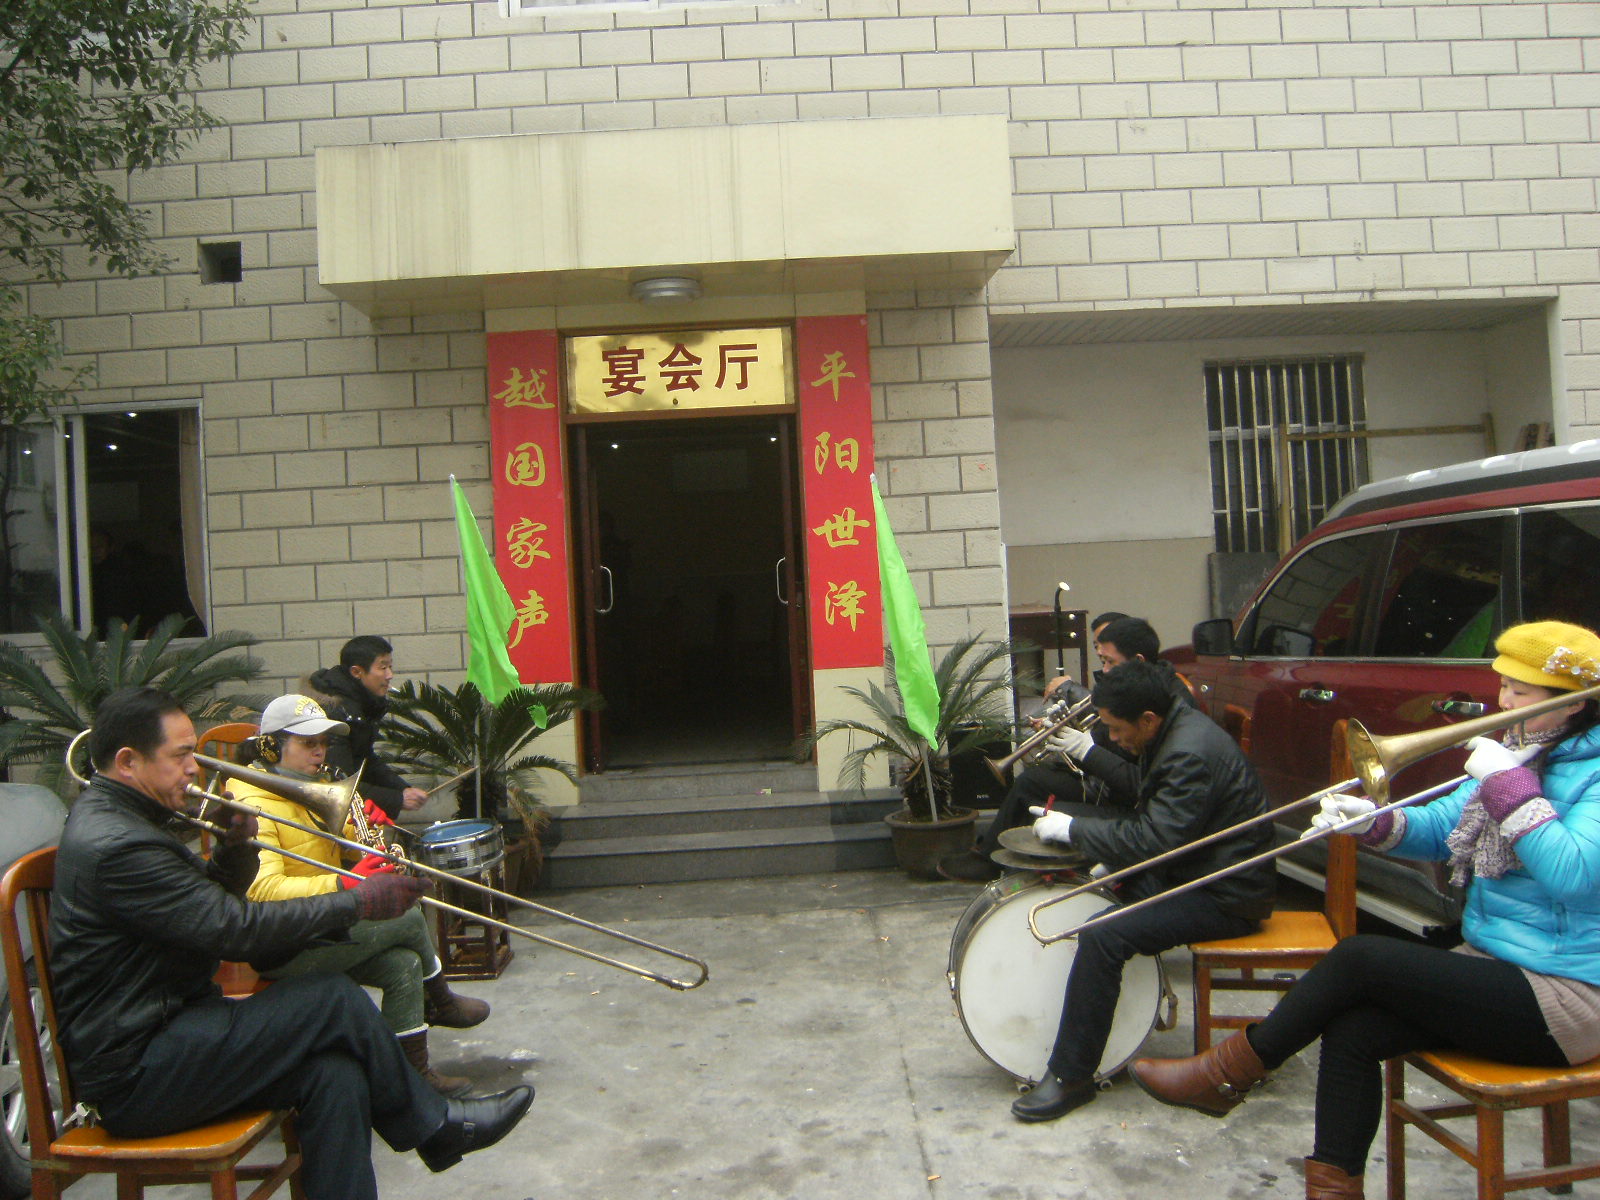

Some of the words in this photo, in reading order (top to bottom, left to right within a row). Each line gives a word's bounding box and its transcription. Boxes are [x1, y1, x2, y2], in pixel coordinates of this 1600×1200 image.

[493, 367, 556, 649] 越国家声
[601, 343, 759, 398] 宴会厅
[811, 351, 870, 632] 平阳世泽
